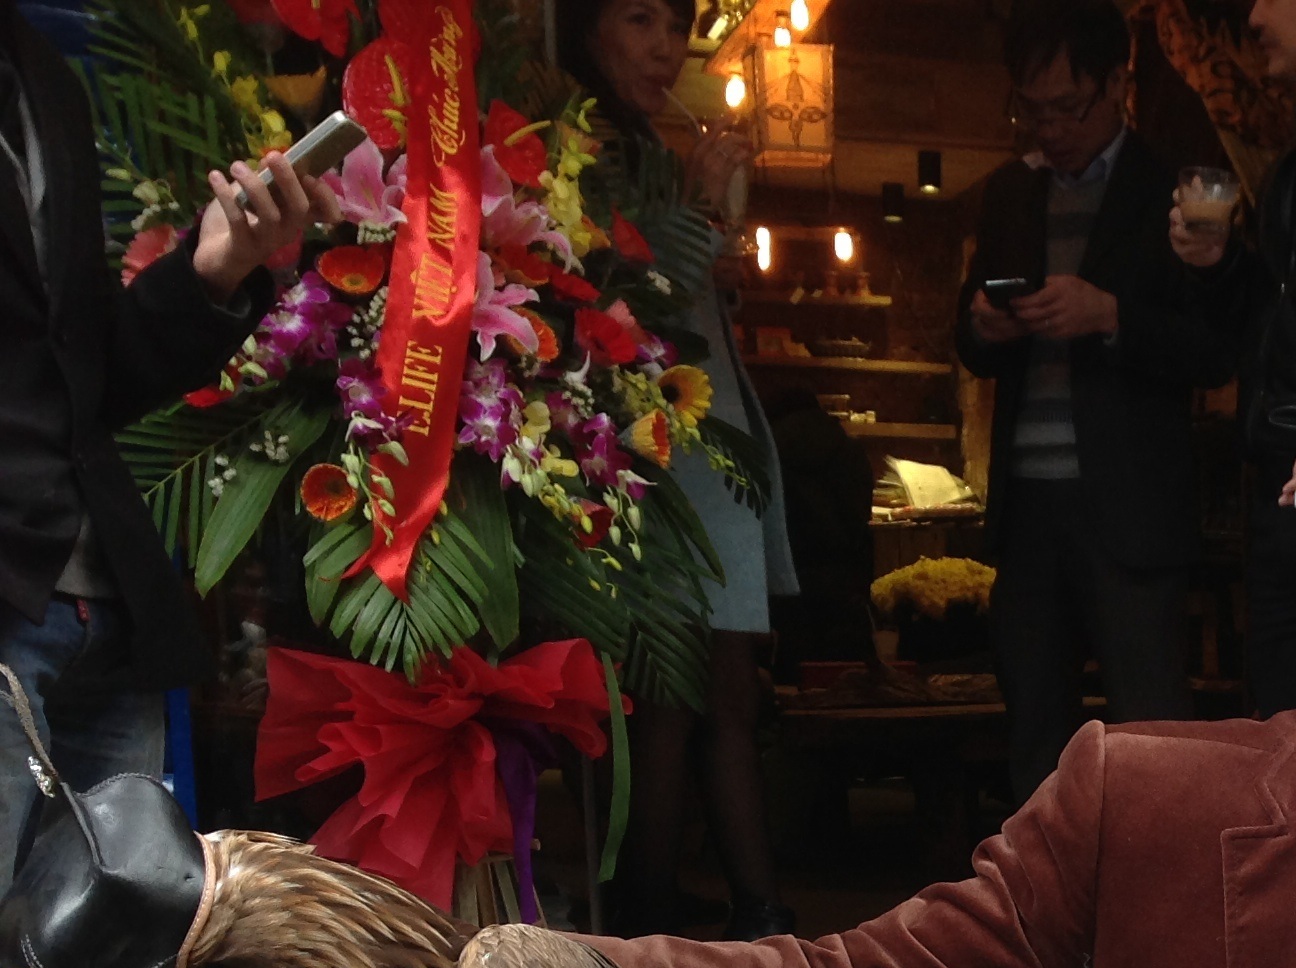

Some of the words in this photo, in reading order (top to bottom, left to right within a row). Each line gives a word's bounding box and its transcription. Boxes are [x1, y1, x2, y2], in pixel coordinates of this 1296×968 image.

[428, 89, 466, 168] Chúc
[427, 182, 458, 252] NAM
[410, 252, 458, 319] VIỆT
